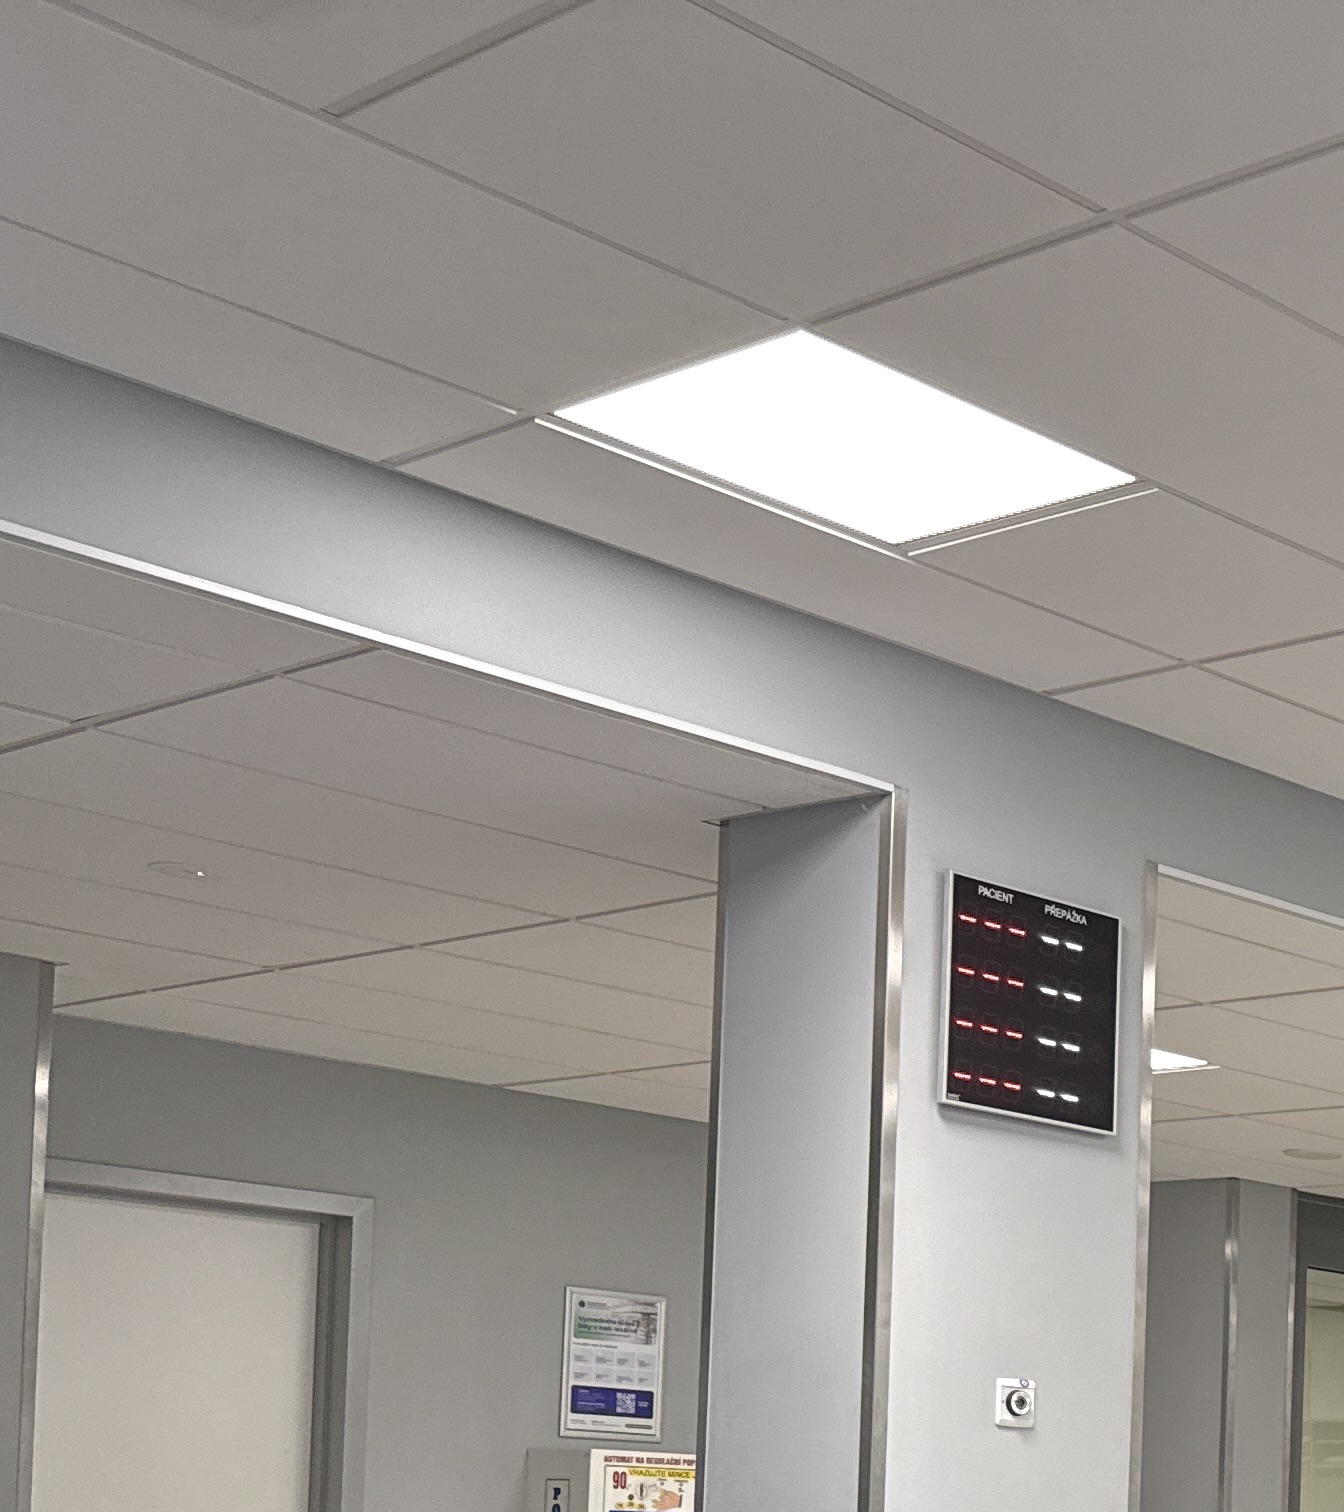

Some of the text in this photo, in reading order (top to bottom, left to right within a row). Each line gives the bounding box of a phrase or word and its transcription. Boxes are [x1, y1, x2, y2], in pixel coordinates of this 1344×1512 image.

[978, 885, 1087, 926] PACIENT PŘEPÁŽKA
[683, 1458, 696, 1466] POP
